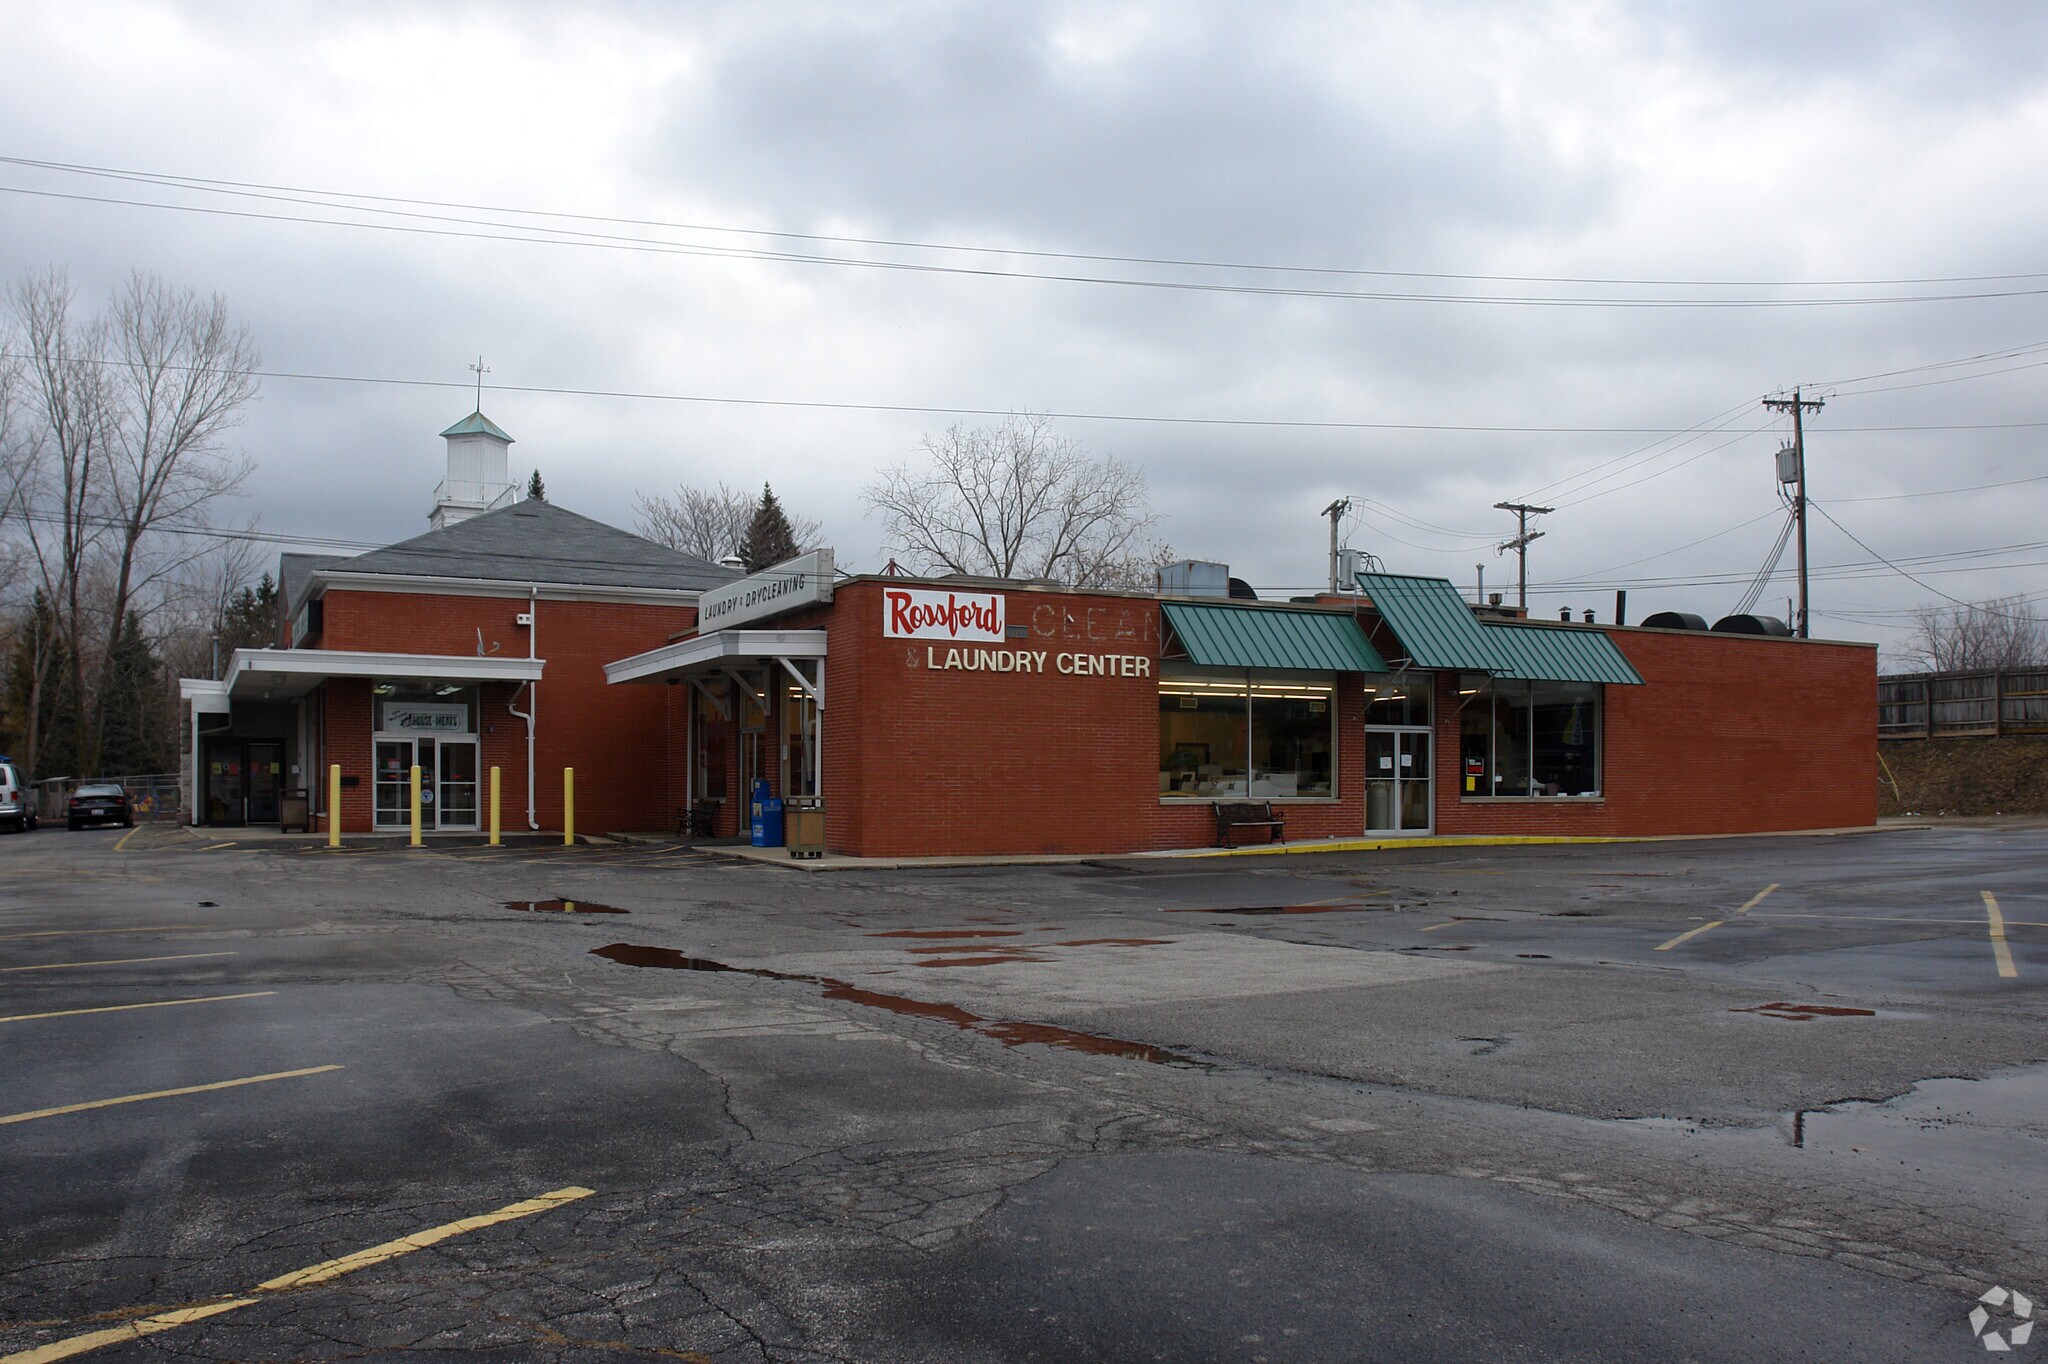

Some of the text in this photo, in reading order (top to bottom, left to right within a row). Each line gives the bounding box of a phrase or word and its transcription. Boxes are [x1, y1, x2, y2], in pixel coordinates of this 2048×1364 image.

[705, 597, 737, 620] LAUNDRY
[746, 573, 805, 607] DRYCLEANING
[886, 591, 1002, 637] Rossford
[927, 646, 1047, 673] LAUNDRY
[1056, 652, 1151, 678] CENTER
